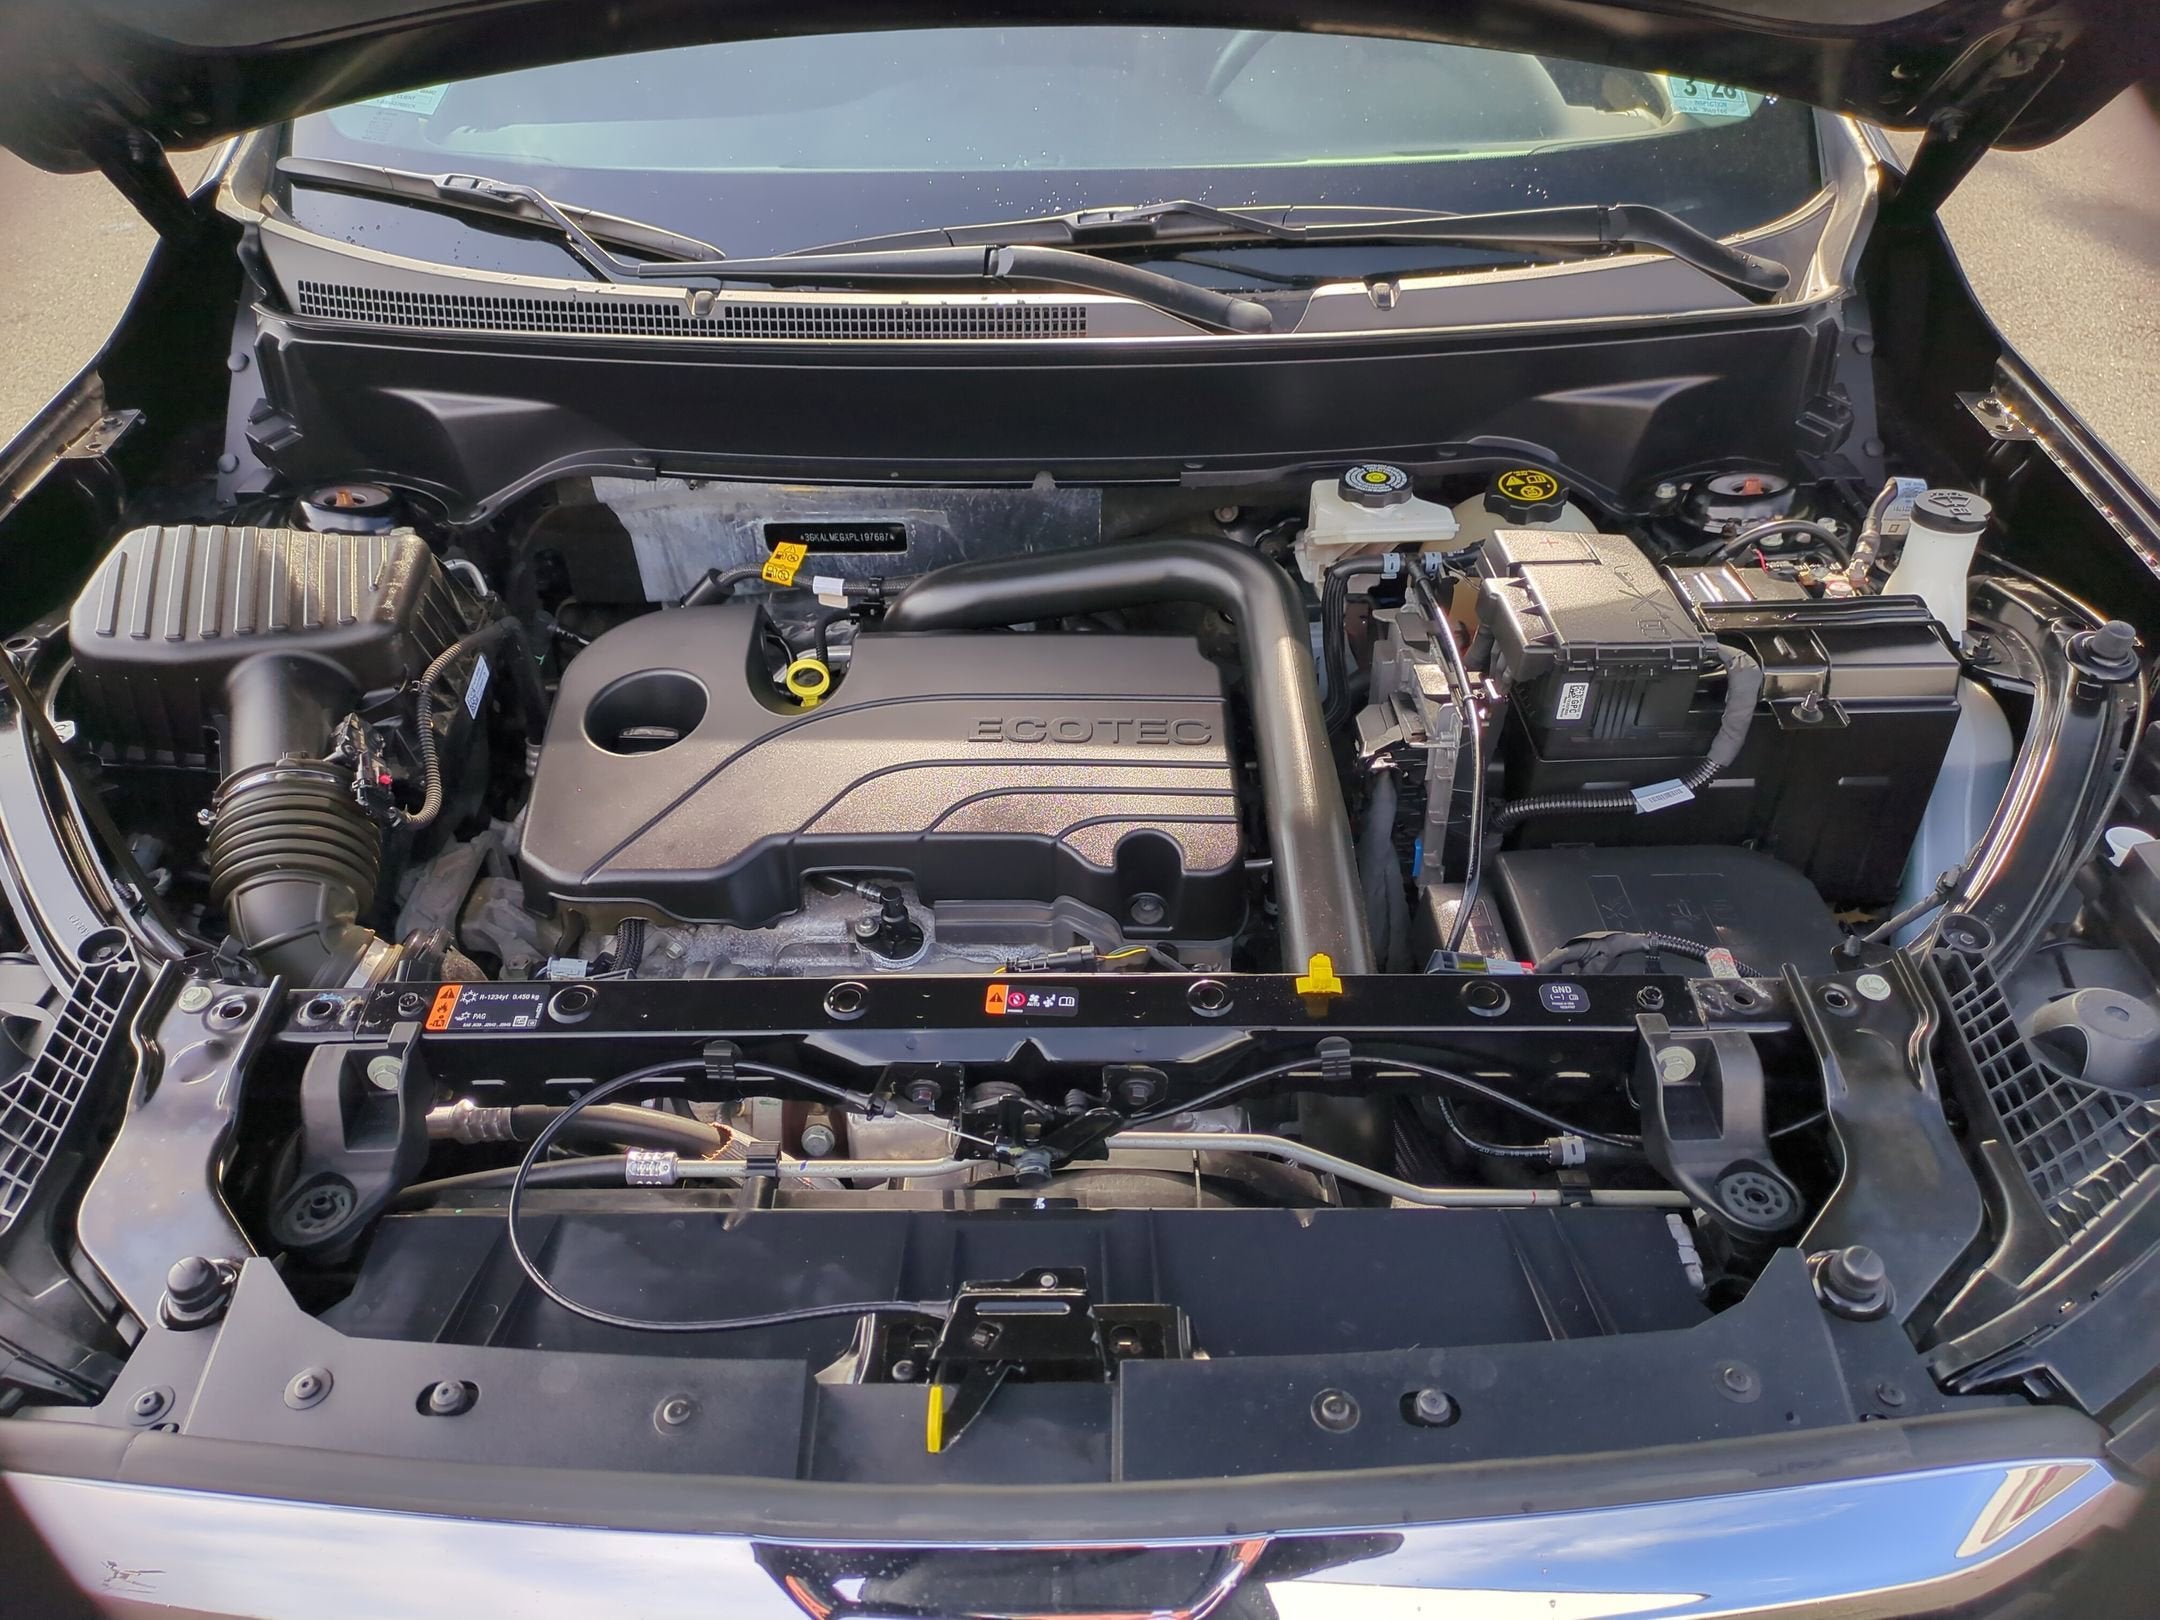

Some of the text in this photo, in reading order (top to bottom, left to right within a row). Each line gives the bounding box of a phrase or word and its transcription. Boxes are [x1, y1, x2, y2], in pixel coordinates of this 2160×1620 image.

[968, 717, 1212, 746] ECOTEC
[1551, 985, 1572, 994] GND
[472, 1012, 487, 1020] PAG
